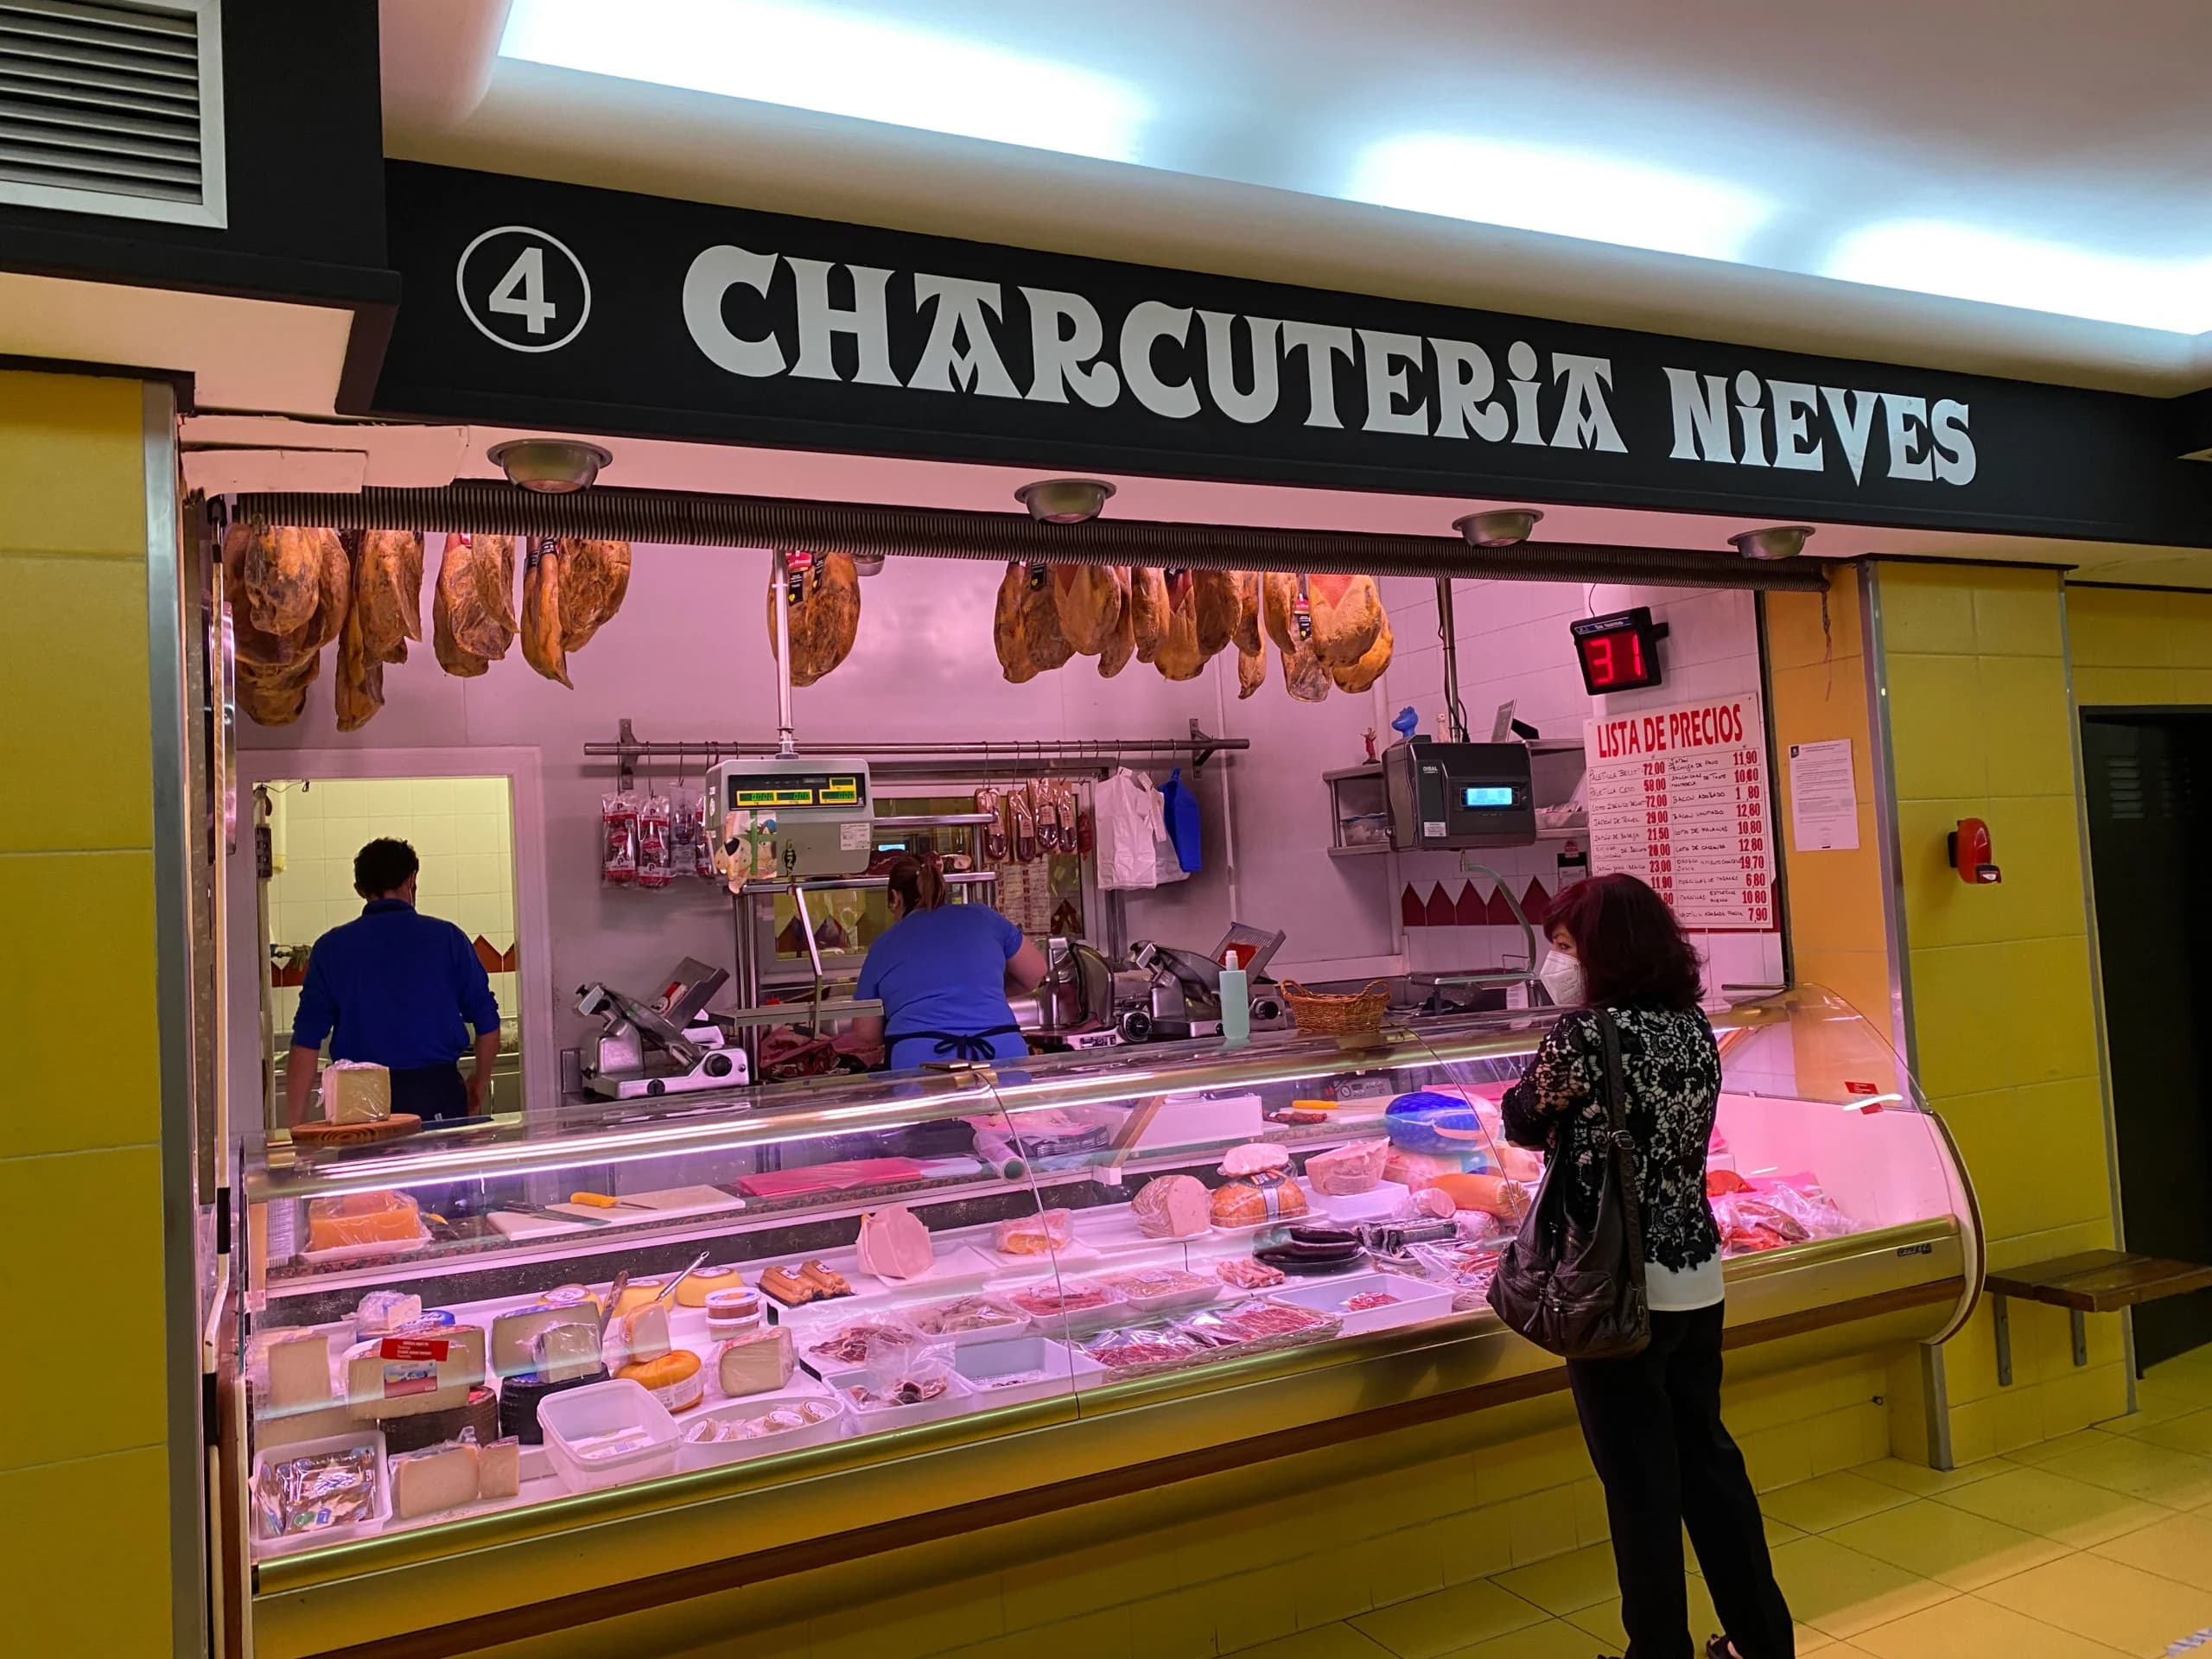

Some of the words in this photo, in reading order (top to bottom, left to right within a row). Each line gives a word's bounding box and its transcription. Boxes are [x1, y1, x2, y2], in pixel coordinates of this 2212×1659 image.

[488, 247, 556, 334] 4
[1589, 633, 1641, 683] 31
[1597, 720, 1640, 758] LISTA
[1644, 716, 1667, 752] DE
[1669, 703, 1743, 749] PRECIOS
[1732, 751, 1758, 766] 11,90
[1643, 761, 1665, 777] 72,00
[1643, 778, 1666, 793] 58,00
[1645, 794, 1668, 810] 72,00
[1647, 827, 1669, 842] 21,50
[1649, 859, 1672, 874] 23,00
[1740, 855, 1764, 871] 19,70
[1650, 875, 1673, 891] 11,90
[1746, 874, 1765, 888] 6,80
[1748, 907, 1768, 923] 7,90
